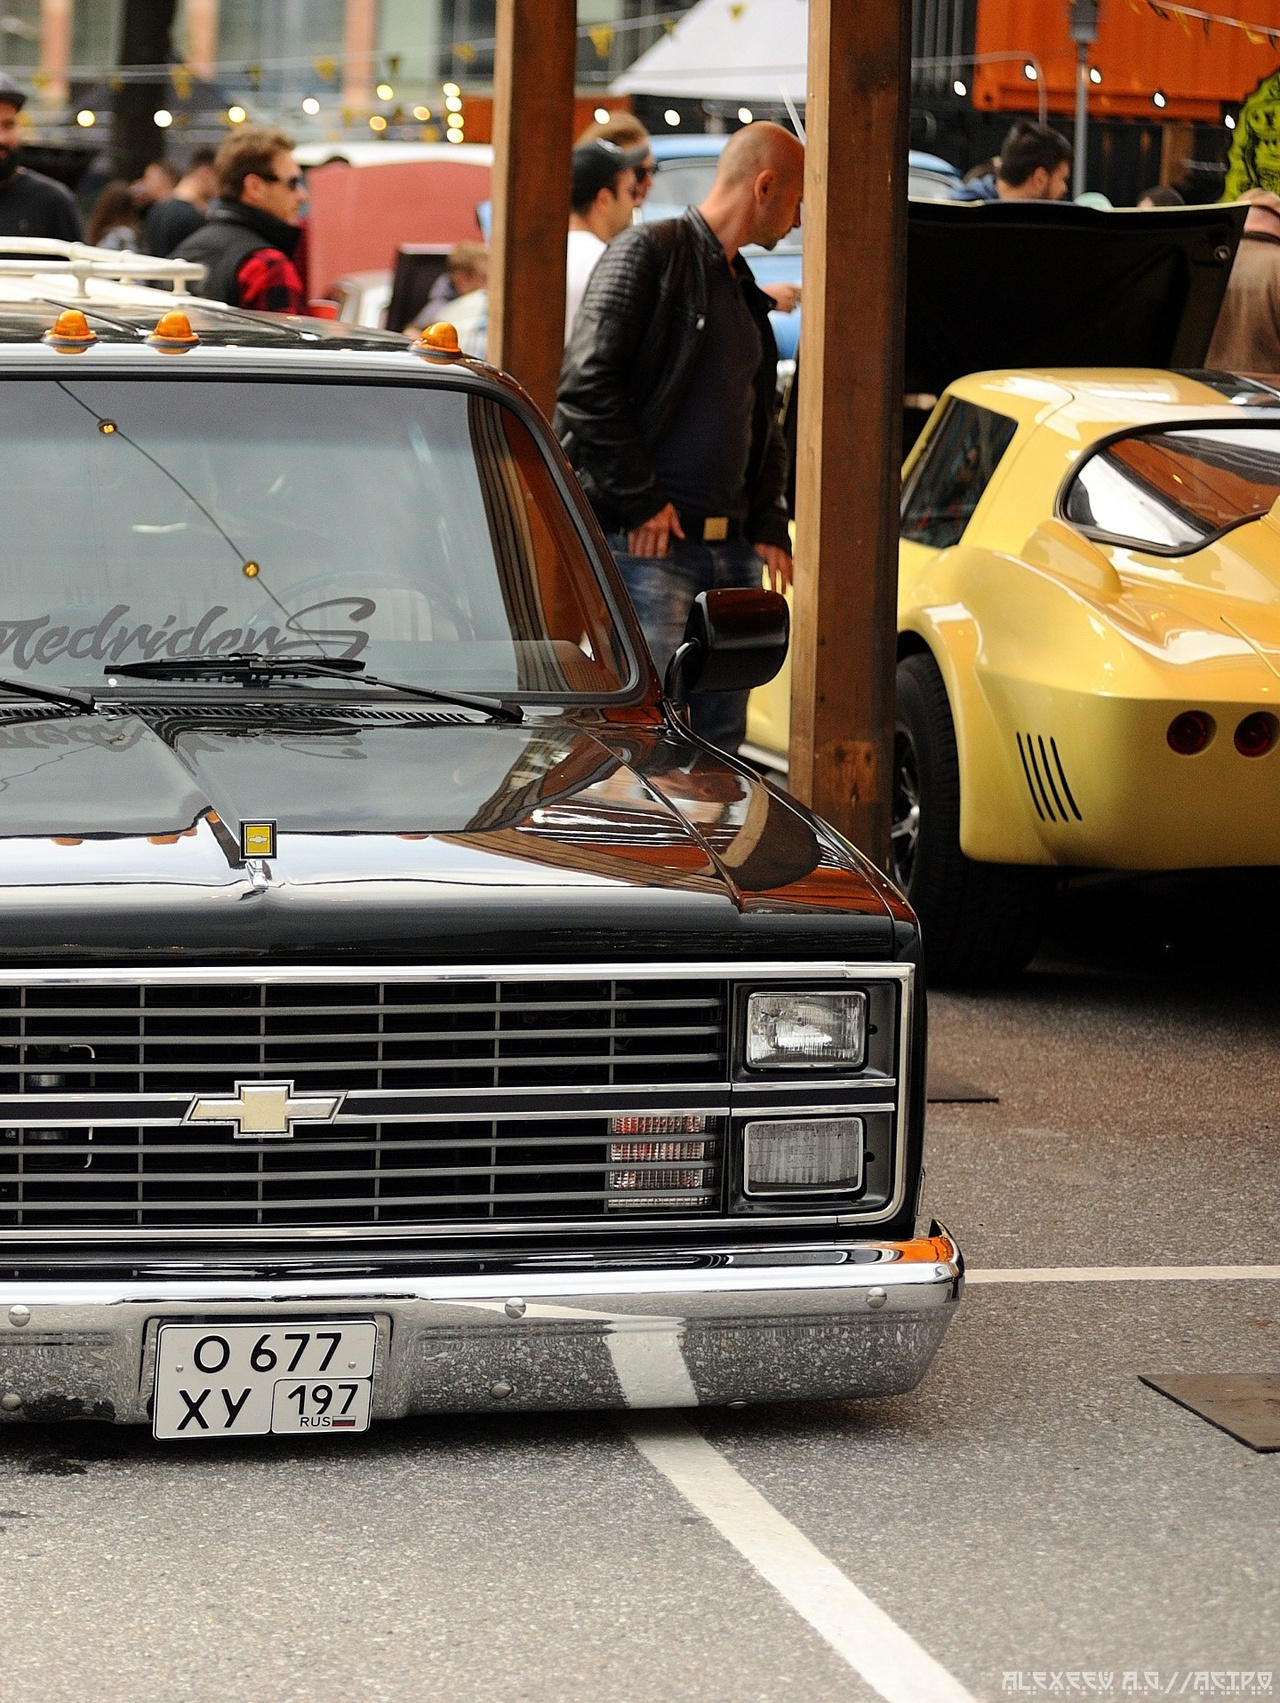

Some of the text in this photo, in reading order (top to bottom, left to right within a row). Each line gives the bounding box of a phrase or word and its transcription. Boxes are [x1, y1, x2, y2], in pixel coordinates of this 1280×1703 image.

[193, 1333, 342, 1374] O 677
[287, 1384, 359, 1415] 197
[299, 1416, 331, 1427] RUS
